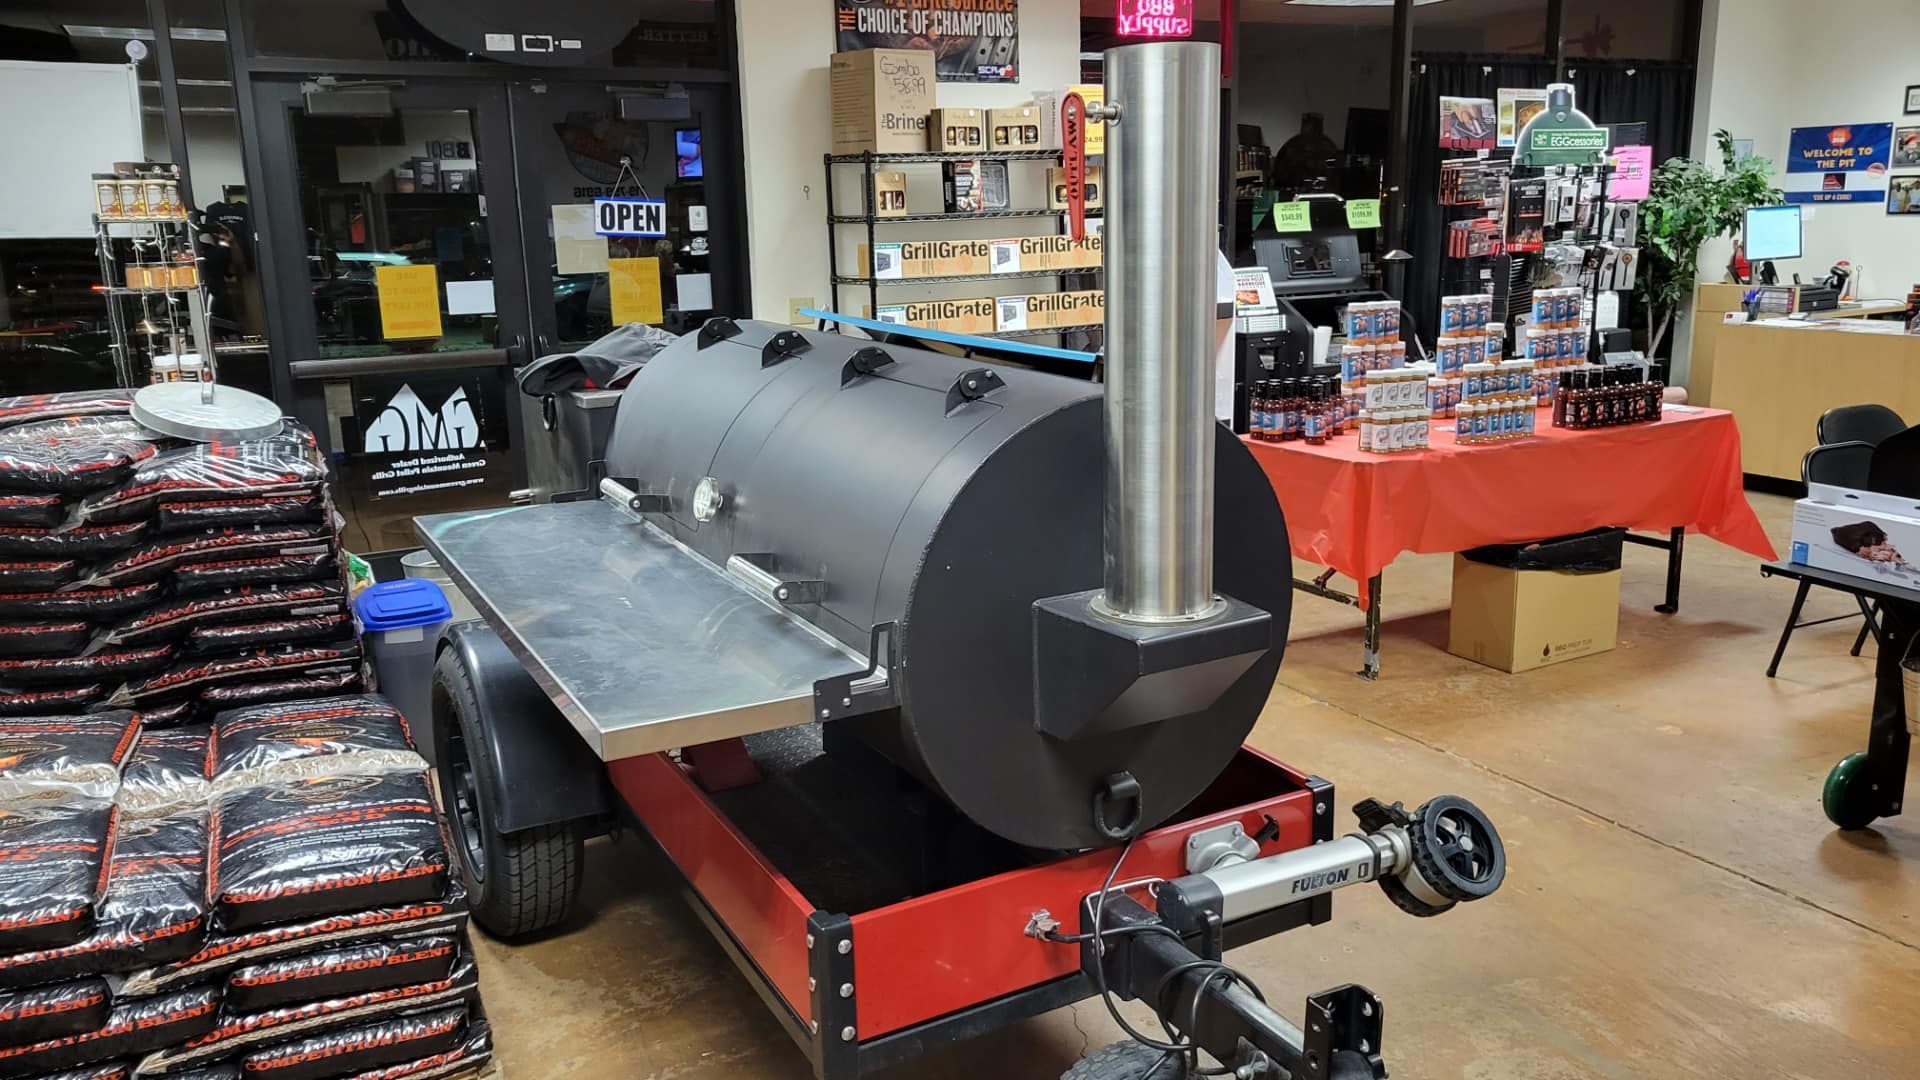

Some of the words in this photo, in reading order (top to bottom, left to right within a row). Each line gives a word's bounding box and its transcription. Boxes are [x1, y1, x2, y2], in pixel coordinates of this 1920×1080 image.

[839, 7, 856, 32] THE
[857, 7, 908, 34] CHOICE
[912, 9, 930, 35] OF
[934, 11, 1014, 37] CHAMPIONS
[879, 55, 921, 77] Combo
[886, 112, 926, 130] Brine
[1551, 136, 1604, 147] EGGcessories
[1803, 147, 1855, 159] WELCOME
[1857, 146, 1874, 157] TO
[1067, 119, 1080, 200] OUTLAW
[1816, 159, 1836, 169] THE
[1839, 158, 1857, 168] PIT
[600, 202, 661, 232] OPEN
[1292, 868, 1349, 894] FULTON
[358, 904, 444, 926] BLEND
[231, 958, 383, 988] COMPETITION
